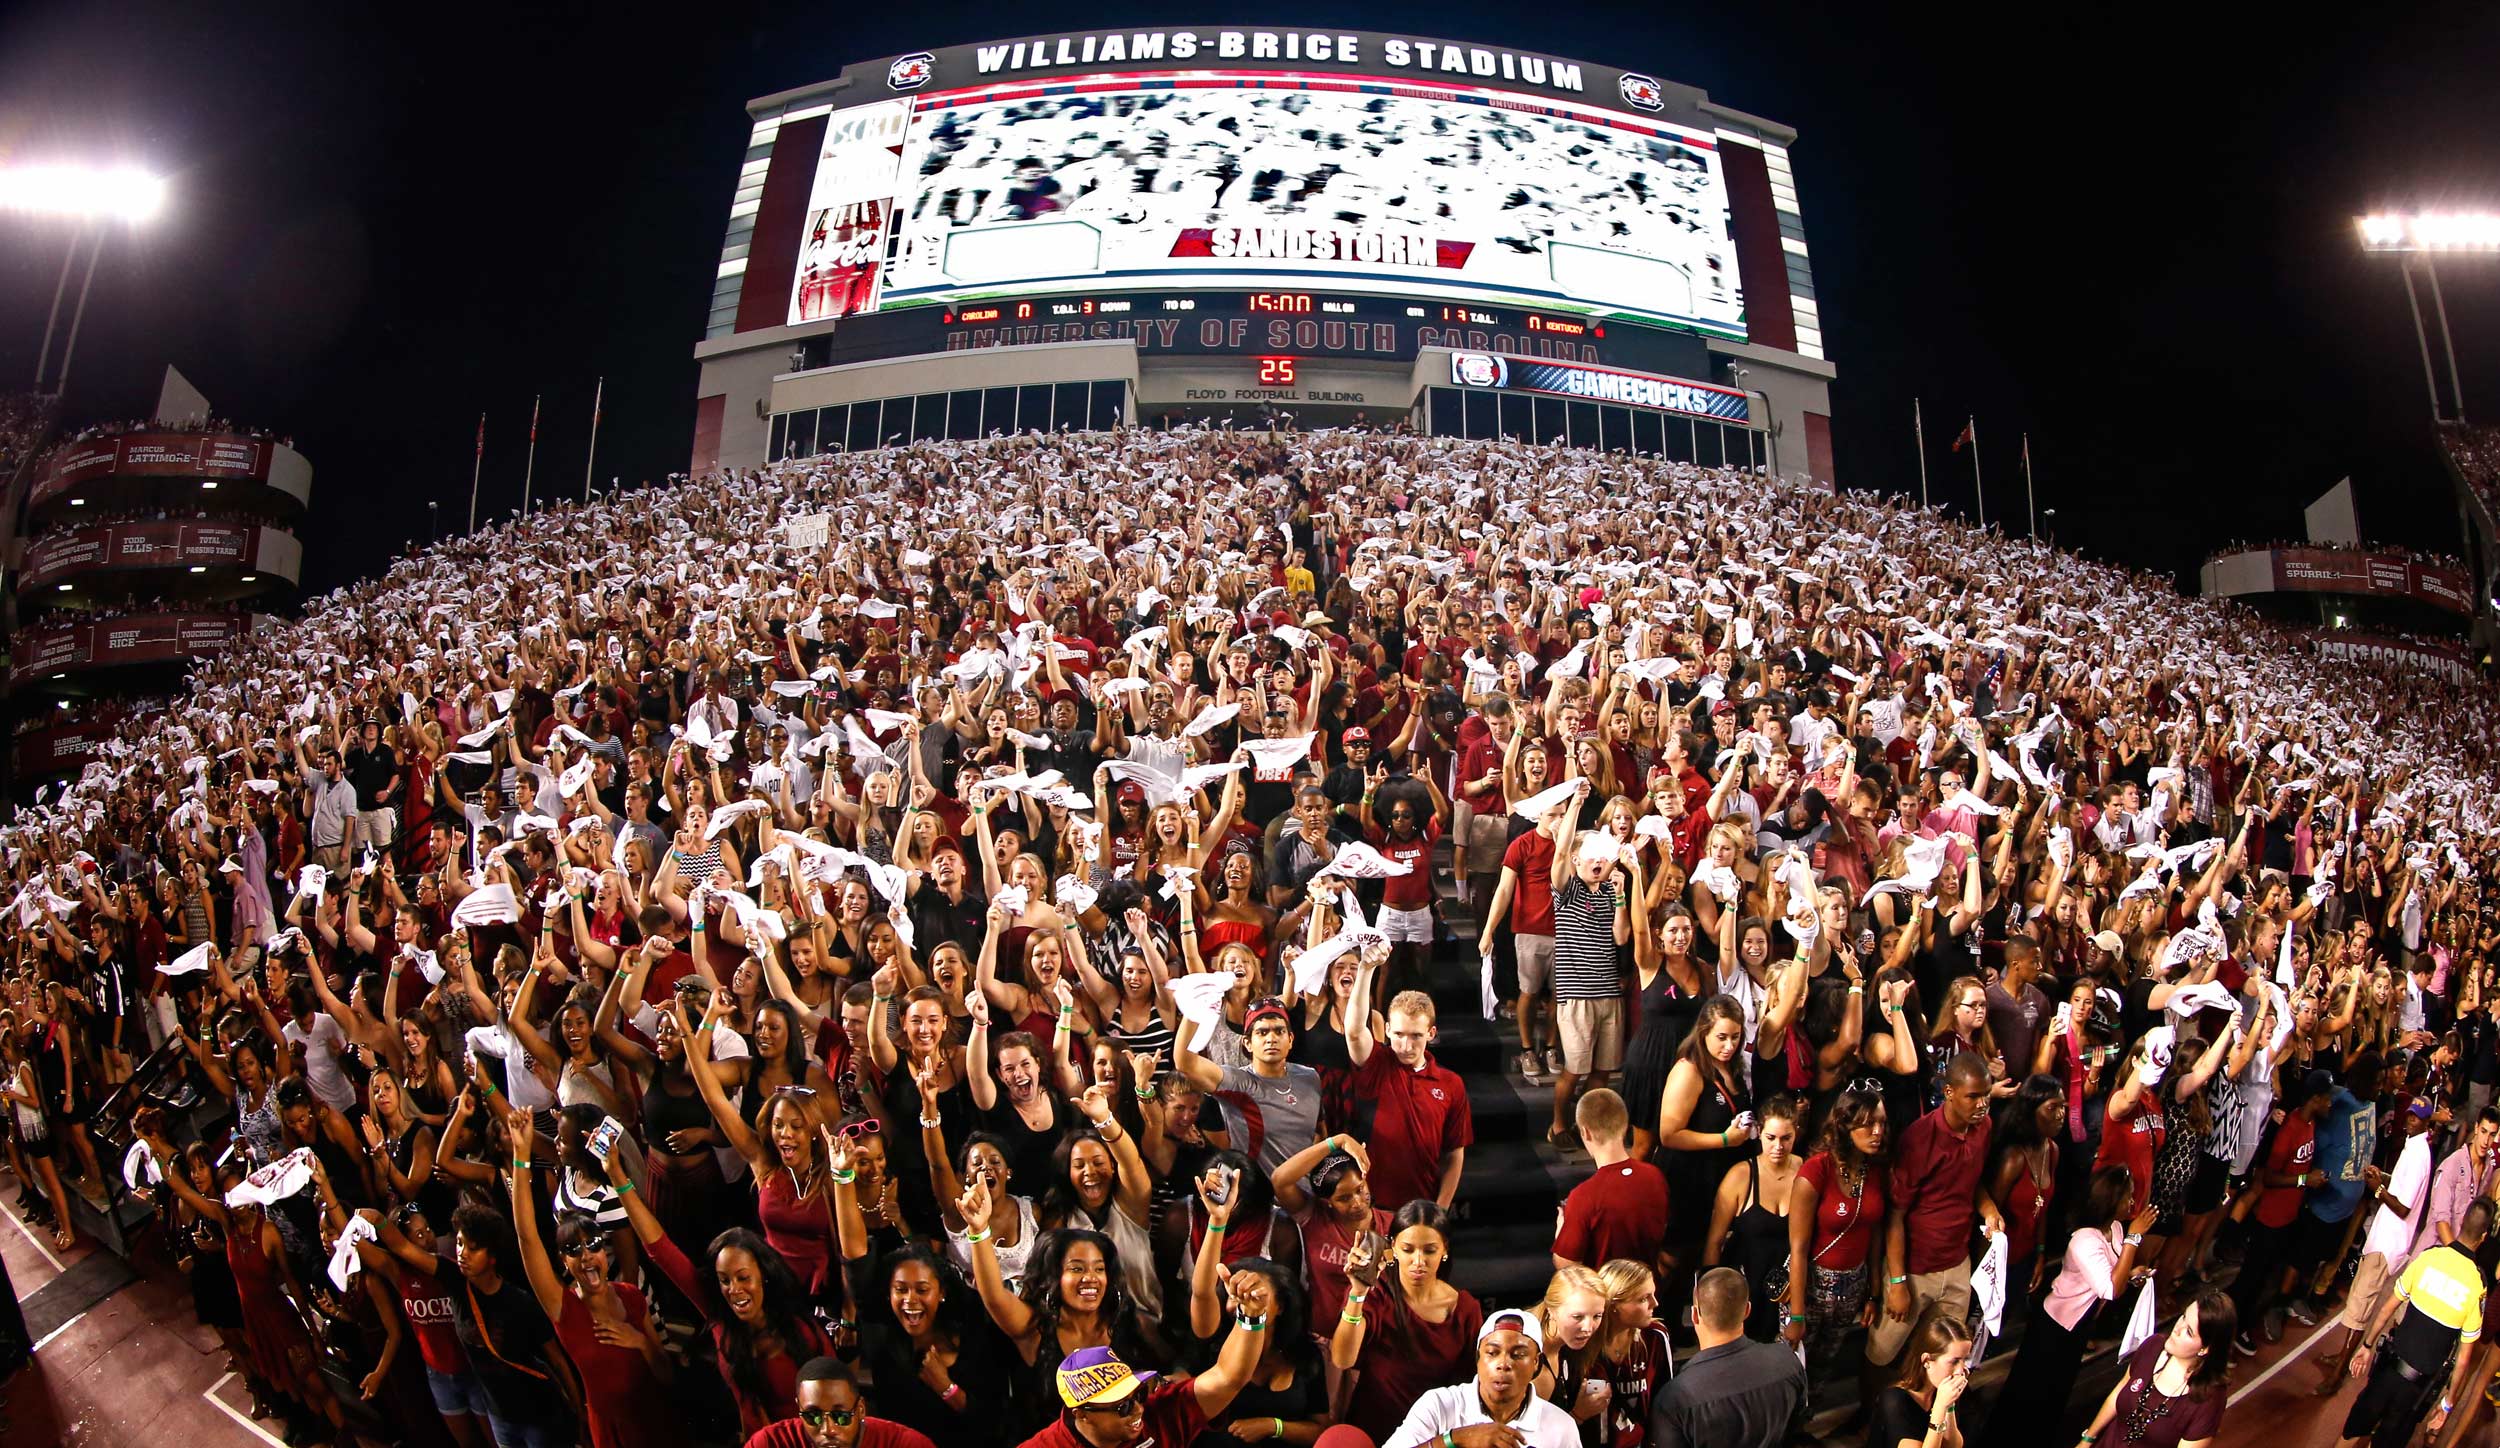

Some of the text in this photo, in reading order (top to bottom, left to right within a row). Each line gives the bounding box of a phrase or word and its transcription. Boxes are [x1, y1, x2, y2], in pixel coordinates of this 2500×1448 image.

[977, 32, 1583, 92] WILLIAMS-BRICE STADIUM
[1488, 98, 1548, 115] UNIVERSITY
[1210, 226, 1438, 268] SANDSTORM
[1084, 301, 1094, 314] 3
[961, 309, 998, 321] CAROLINA
[1546, 321, 1584, 335] KENTUCKY
[947, 318, 1600, 366] UNIVERSITY OF SOUTH CAROLINA
[1260, 359, 1294, 382] 25
[1186, 389, 1364, 403] FLOYD FOOTBALL BUILDING
[1568, 368, 1708, 414] GAMECOCKS
[128, 453, 191, 464] LATTIMORE
[790, 528, 827, 546] COCKPIT
[122, 544, 152, 554] ELLIS
[2422, 574, 2442, 585] STEVE
[109, 630, 141, 638] SIDNEY
[181, 630, 224, 638] TOUCHDOWN
[108, 638, 136, 648] RICE
[53, 735, 82, 747] ALSHON
[53, 740, 97, 757] JEFFERY
[1255, 767, 1290, 782] OBEY
[2418, 1265, 2471, 1312] POLICE
[1617, 1379, 1648, 1394] LINA
